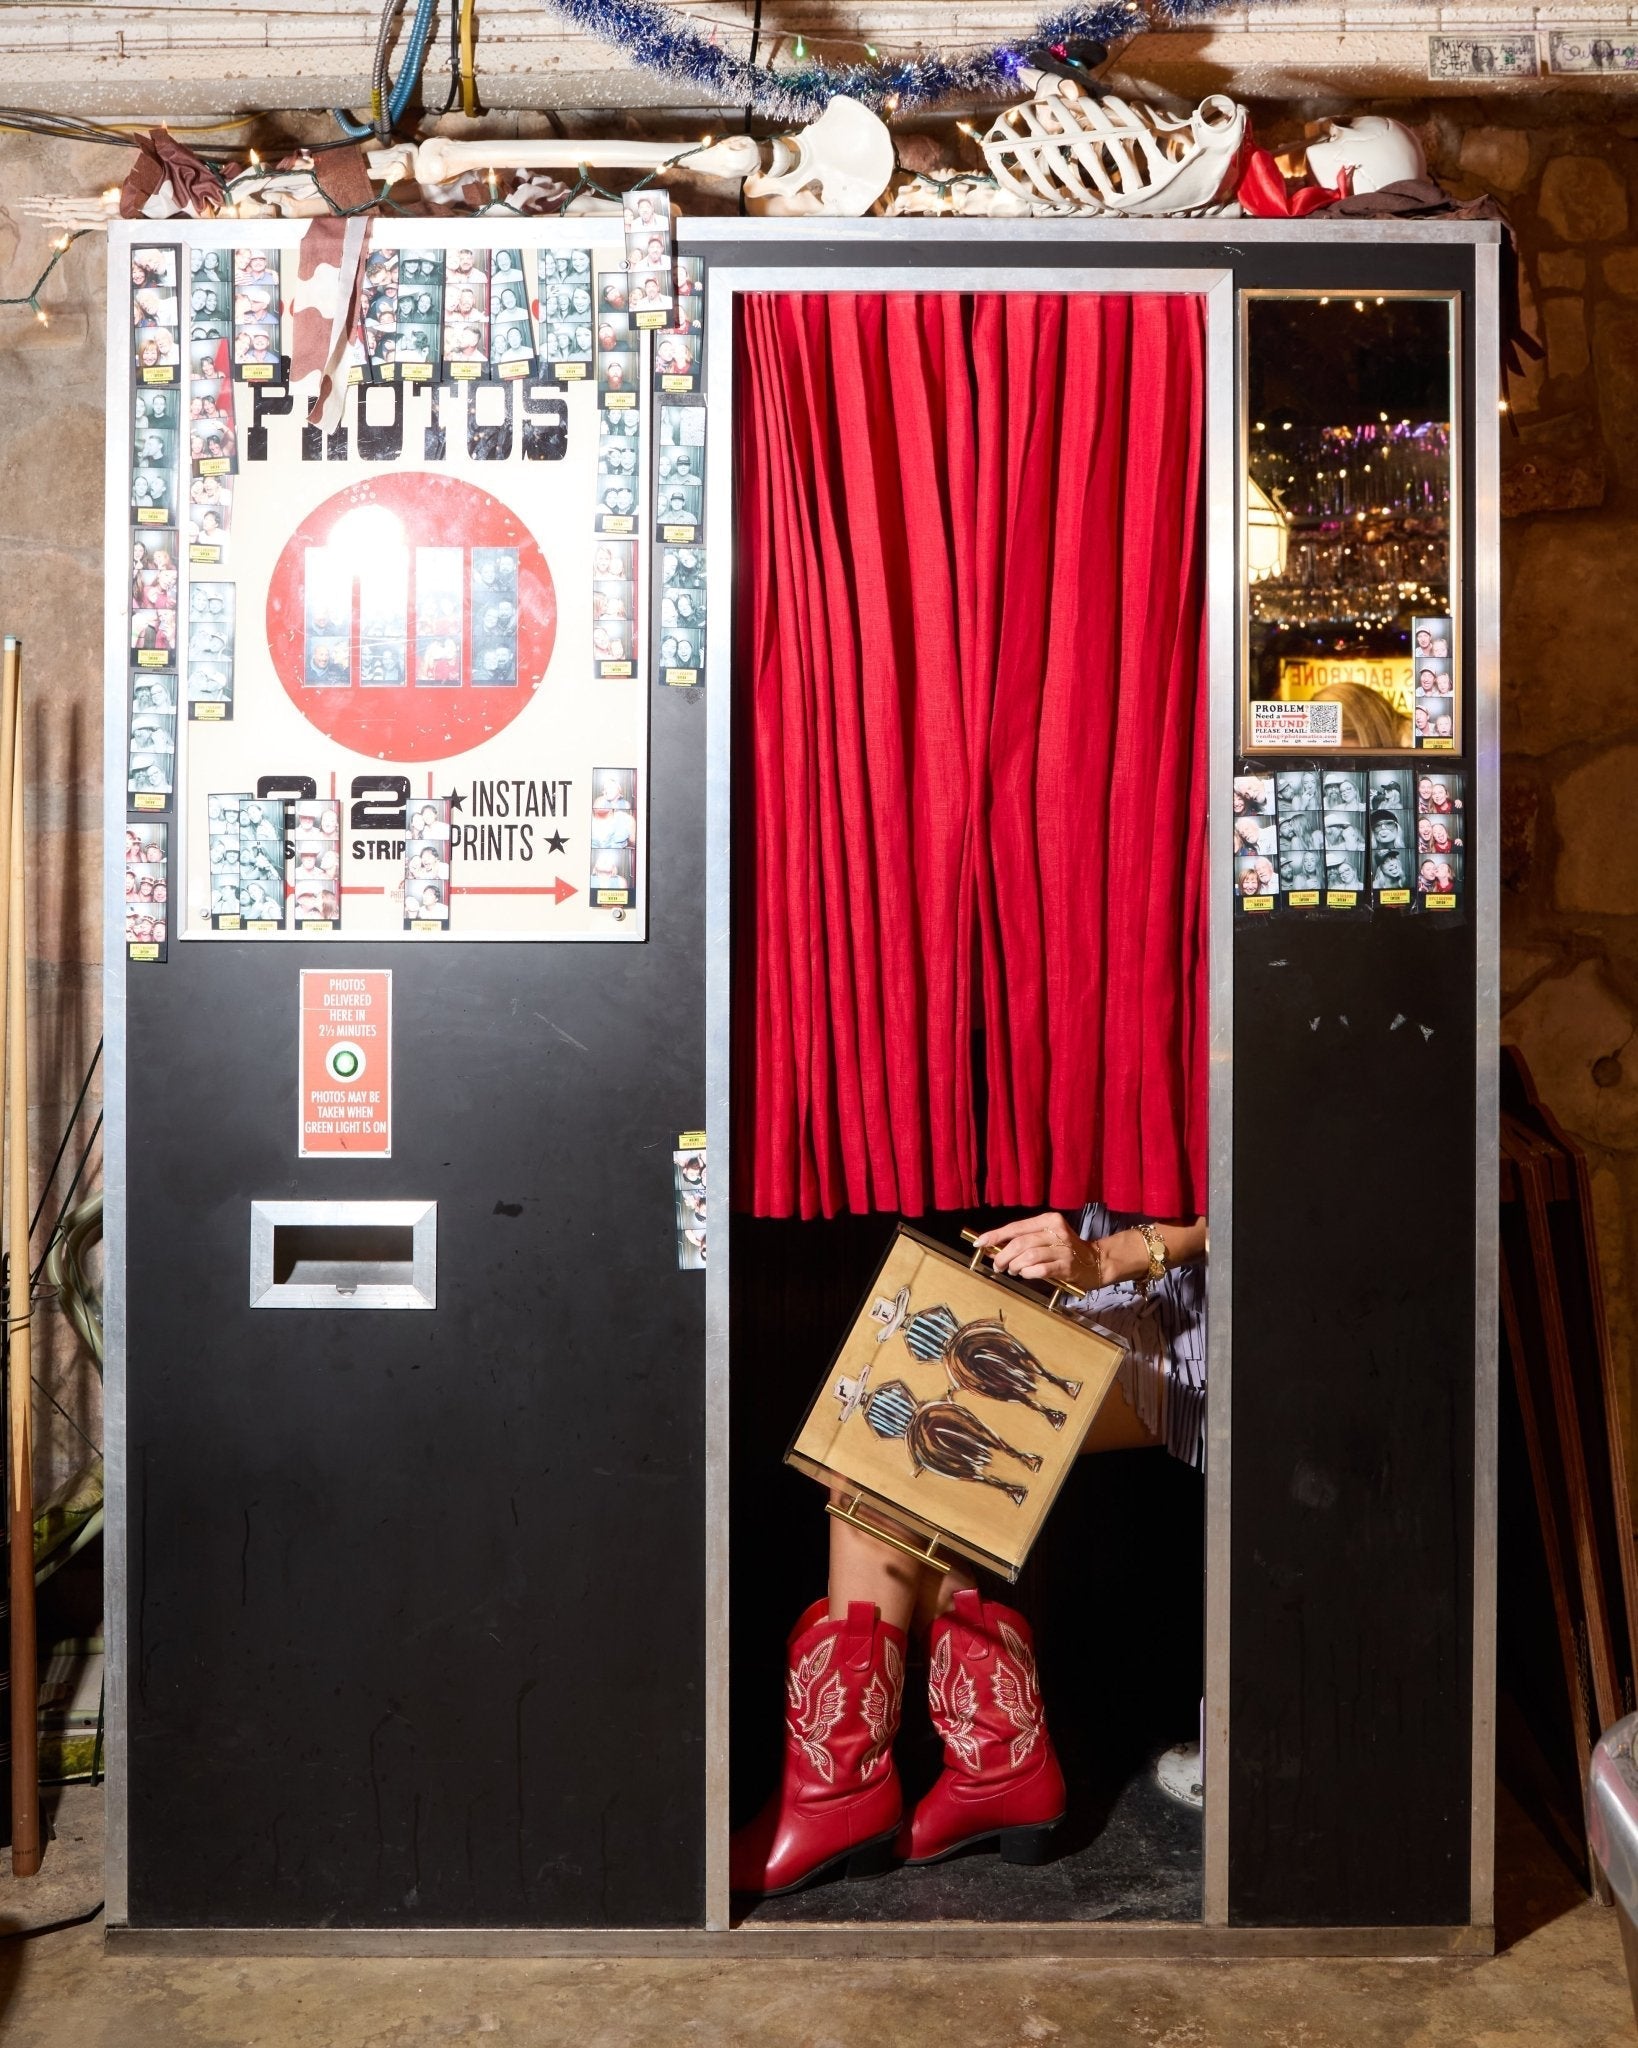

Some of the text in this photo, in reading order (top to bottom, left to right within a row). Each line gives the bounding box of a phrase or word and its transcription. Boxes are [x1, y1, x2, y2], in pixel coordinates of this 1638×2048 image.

[351, 775, 411, 830] 2
[472, 780, 573, 817] INSTANT
[451, 824, 534, 861] PRINTS
[329, 979, 366, 991] PHOTOS
[323, 994, 372, 1006] DELIVERED
[329, 1009, 366, 1022] HERE IN
[336, 1024, 377, 1037] MINUTES
[311, 1091, 380, 1103] PHOTOS MAY BE
[317, 1106, 374, 1118] TAKEN WHEN
[305, 1121, 387, 1134] GREEN LIGHT IS ON
